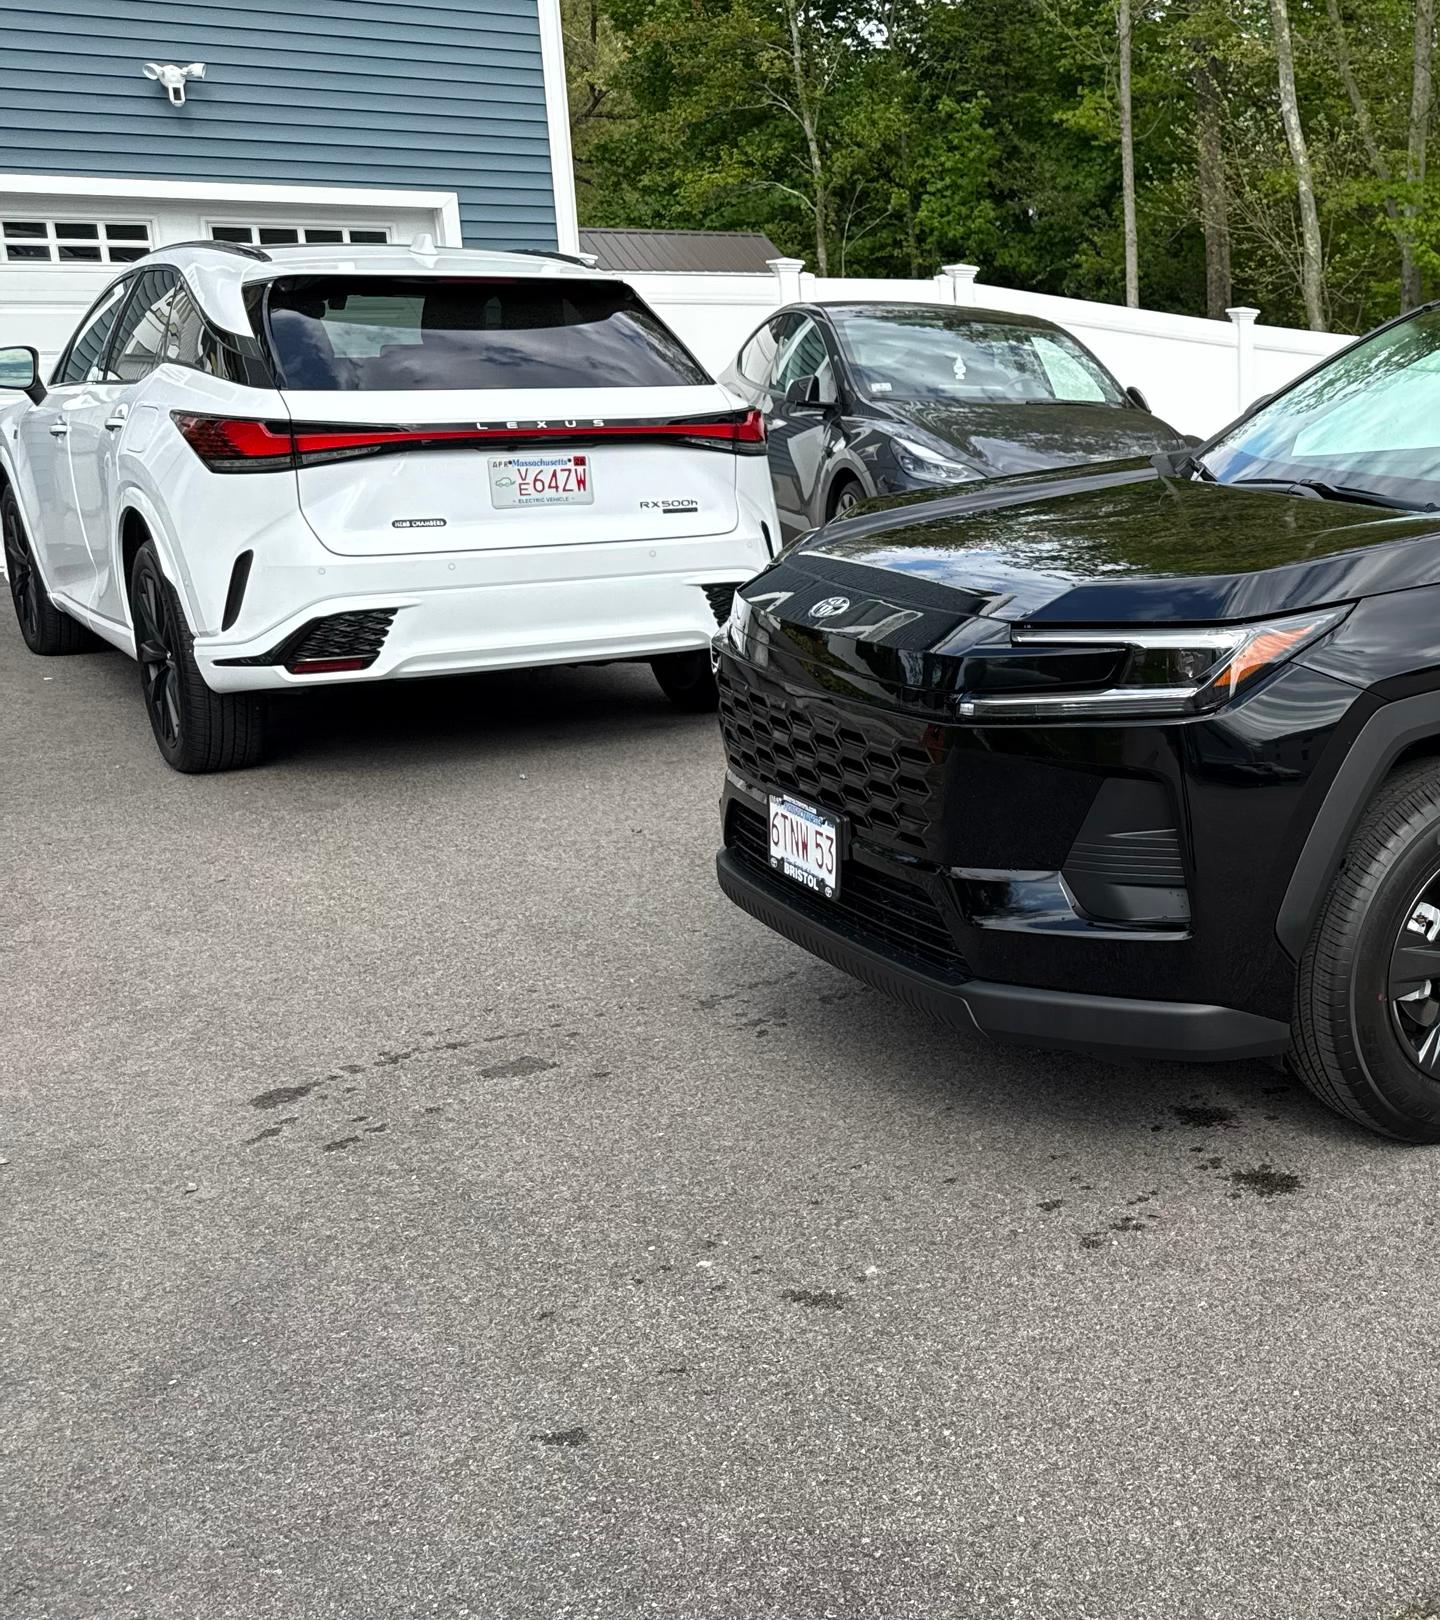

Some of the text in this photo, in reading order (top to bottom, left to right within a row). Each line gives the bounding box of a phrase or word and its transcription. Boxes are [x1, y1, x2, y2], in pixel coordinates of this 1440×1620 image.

[476, 419, 605, 430] LEXUS
[511, 458, 568, 468] Massachusetts
[815, 829, 834, 875] 53
[783, 861, 819, 891] BRISTOL
